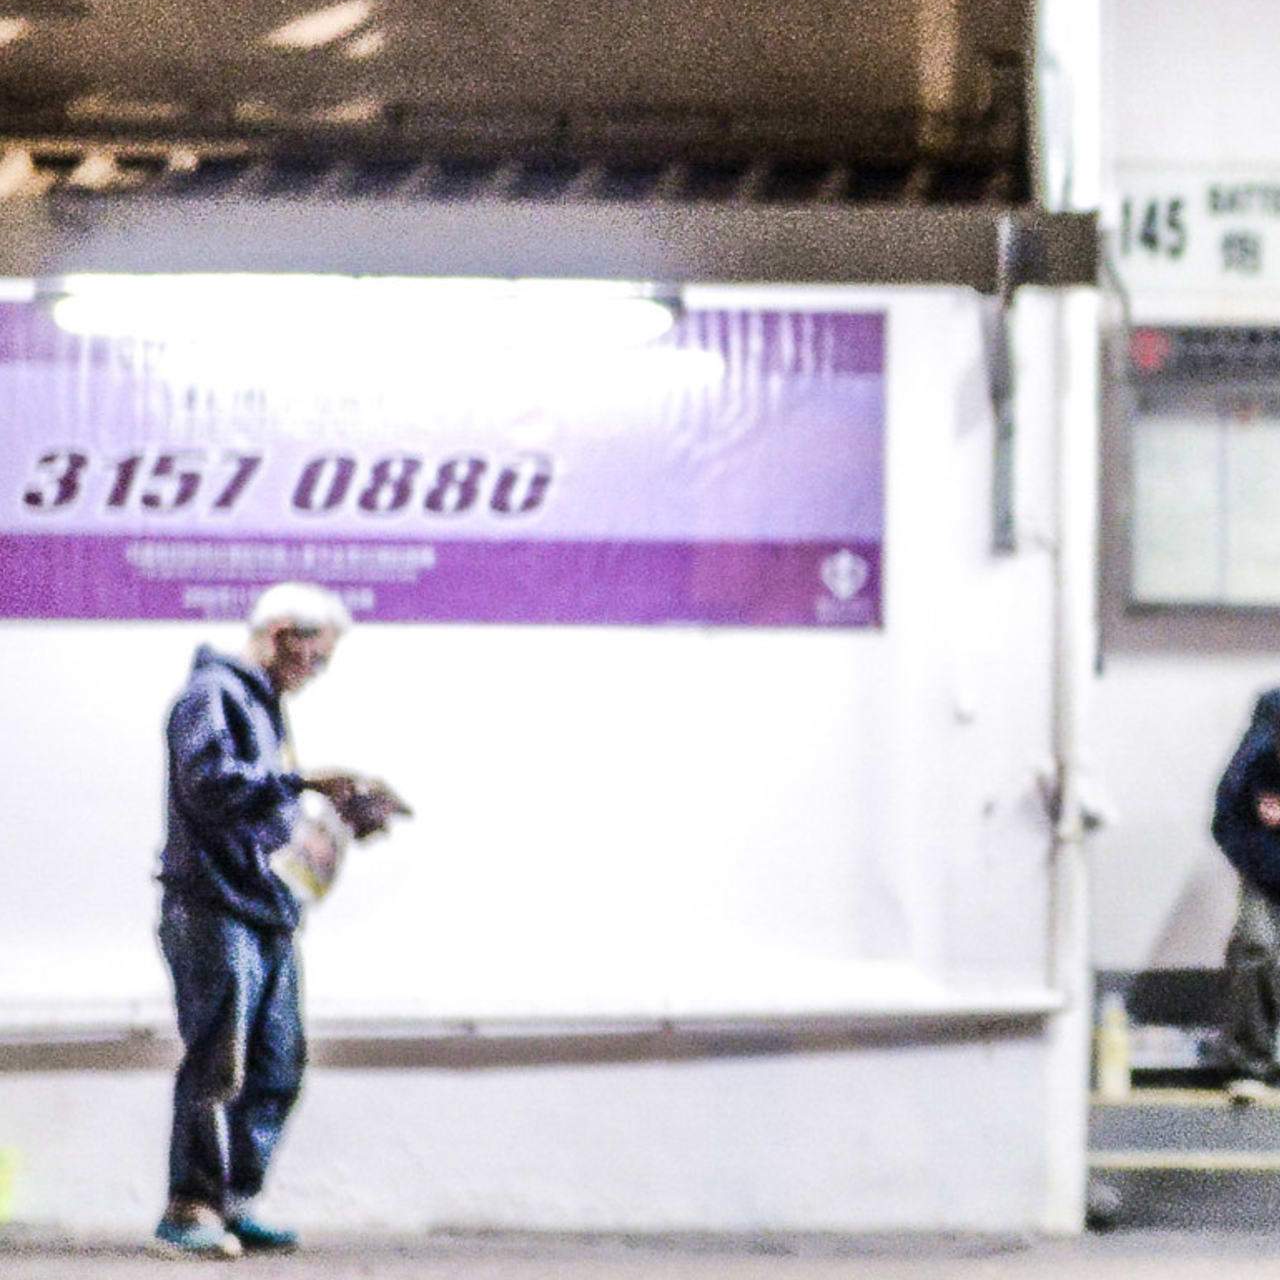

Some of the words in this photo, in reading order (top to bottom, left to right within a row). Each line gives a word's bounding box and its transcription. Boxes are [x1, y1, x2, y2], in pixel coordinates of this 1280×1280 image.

[1120, 194, 1187, 259] 145
[22, 452, 264, 510] 3157
[291, 454, 554, 515] 0880
